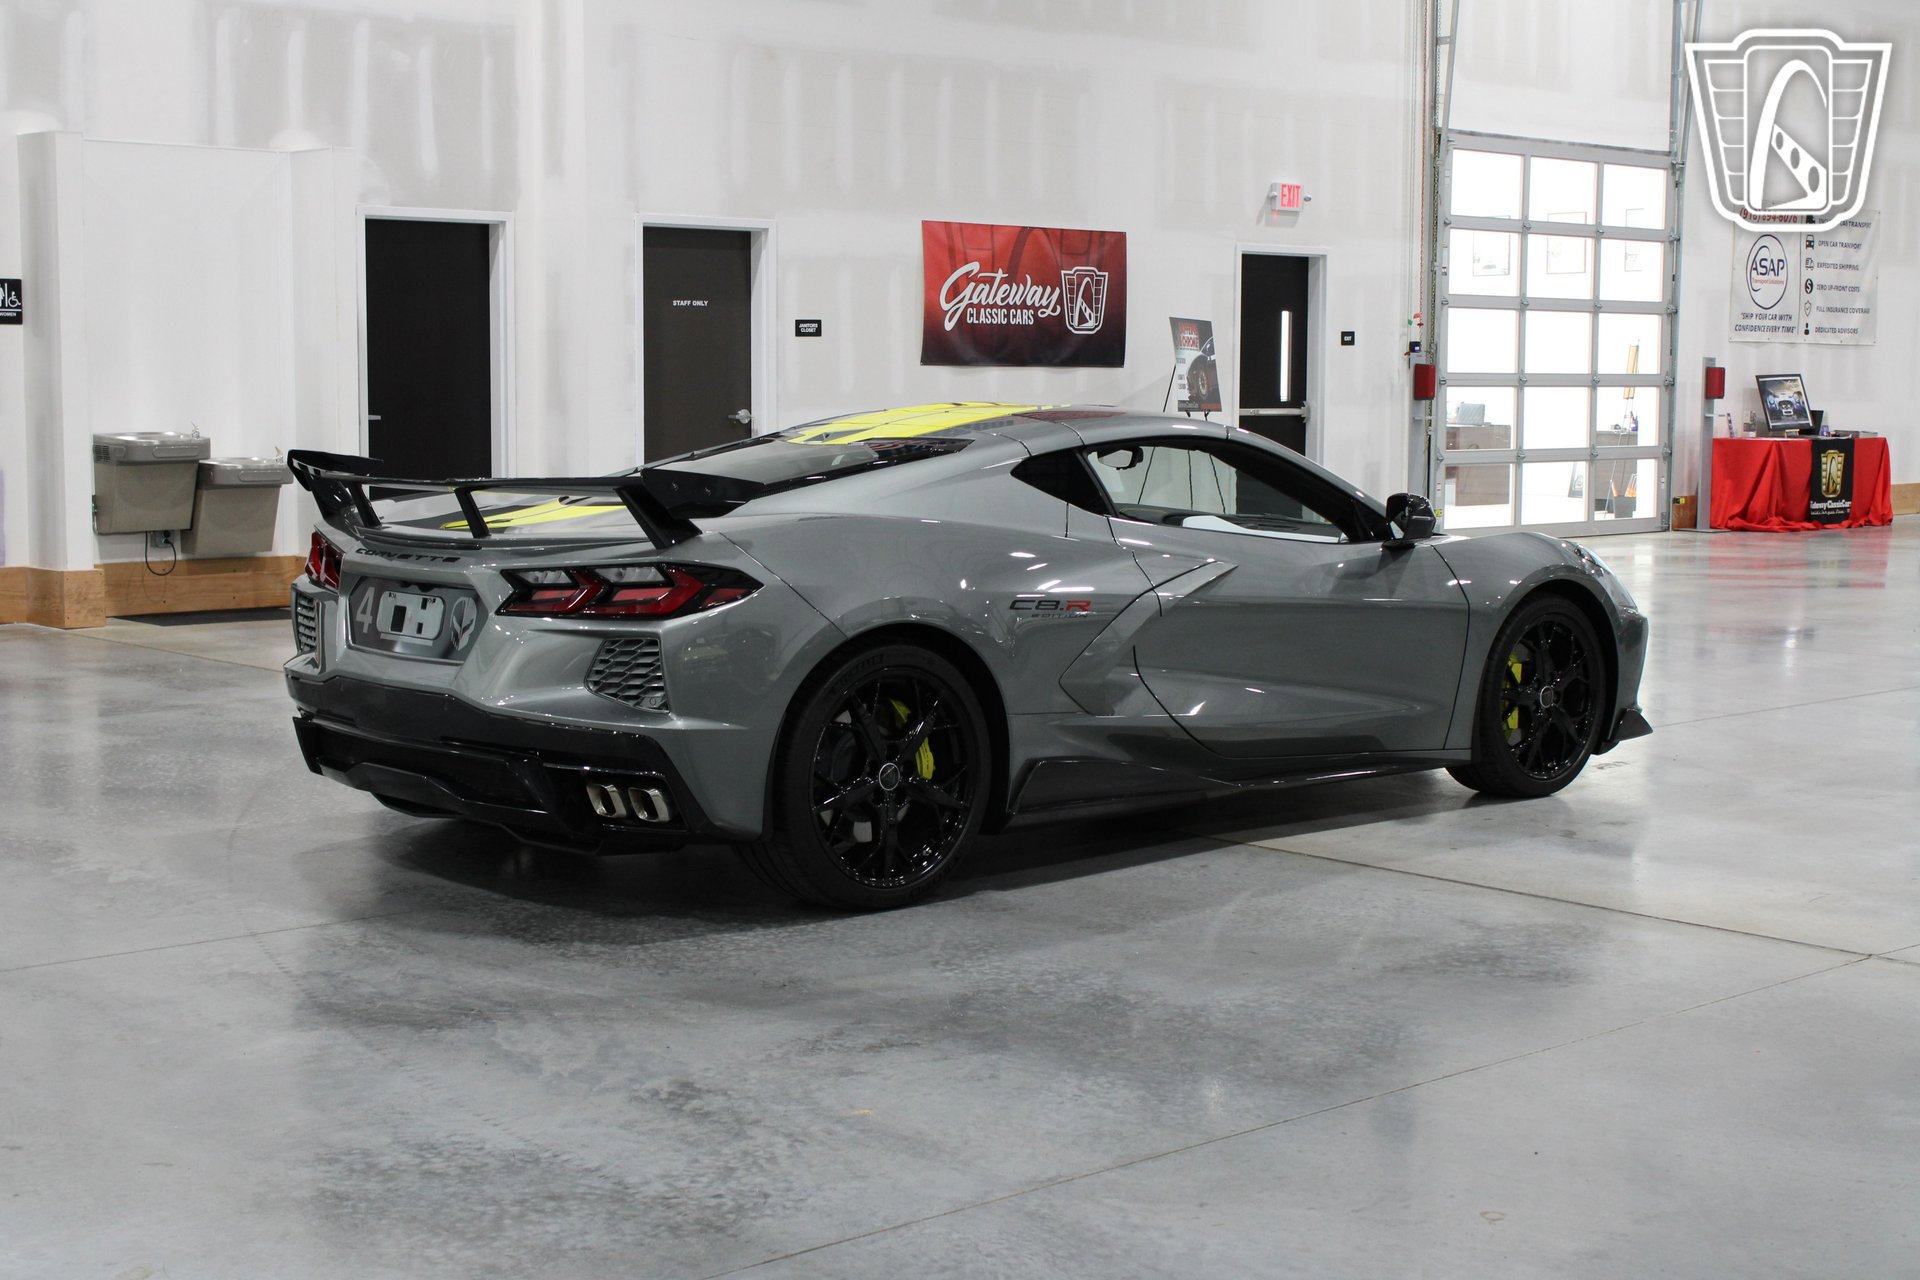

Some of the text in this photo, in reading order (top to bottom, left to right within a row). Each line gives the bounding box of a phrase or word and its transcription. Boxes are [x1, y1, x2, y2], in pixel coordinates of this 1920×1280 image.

[1281, 184, 1301, 208] EXIT
[1751, 258, 1785, 277] ASAP
[1817, 262, 1860, 271] EXPEDITED SHIPPING
[940, 261, 1061, 331] Gateway
[966, 308, 1034, 325] CLASSIC CARS
[1826, 306, 1849, 314] INSURANCE
[1755, 313, 1768, 321] YOUR
[1778, 314, 1793, 322] WITH
[1734, 324, 1766, 333] CONFIDENCE
[1765, 325, 1781, 333] EVERY
[1838, 327, 1859, 335] ADVISORS
[355, 548, 461, 563] CORVETTE
[356, 586, 375, 634] 4
[1009, 599, 1092, 612] C8.R
